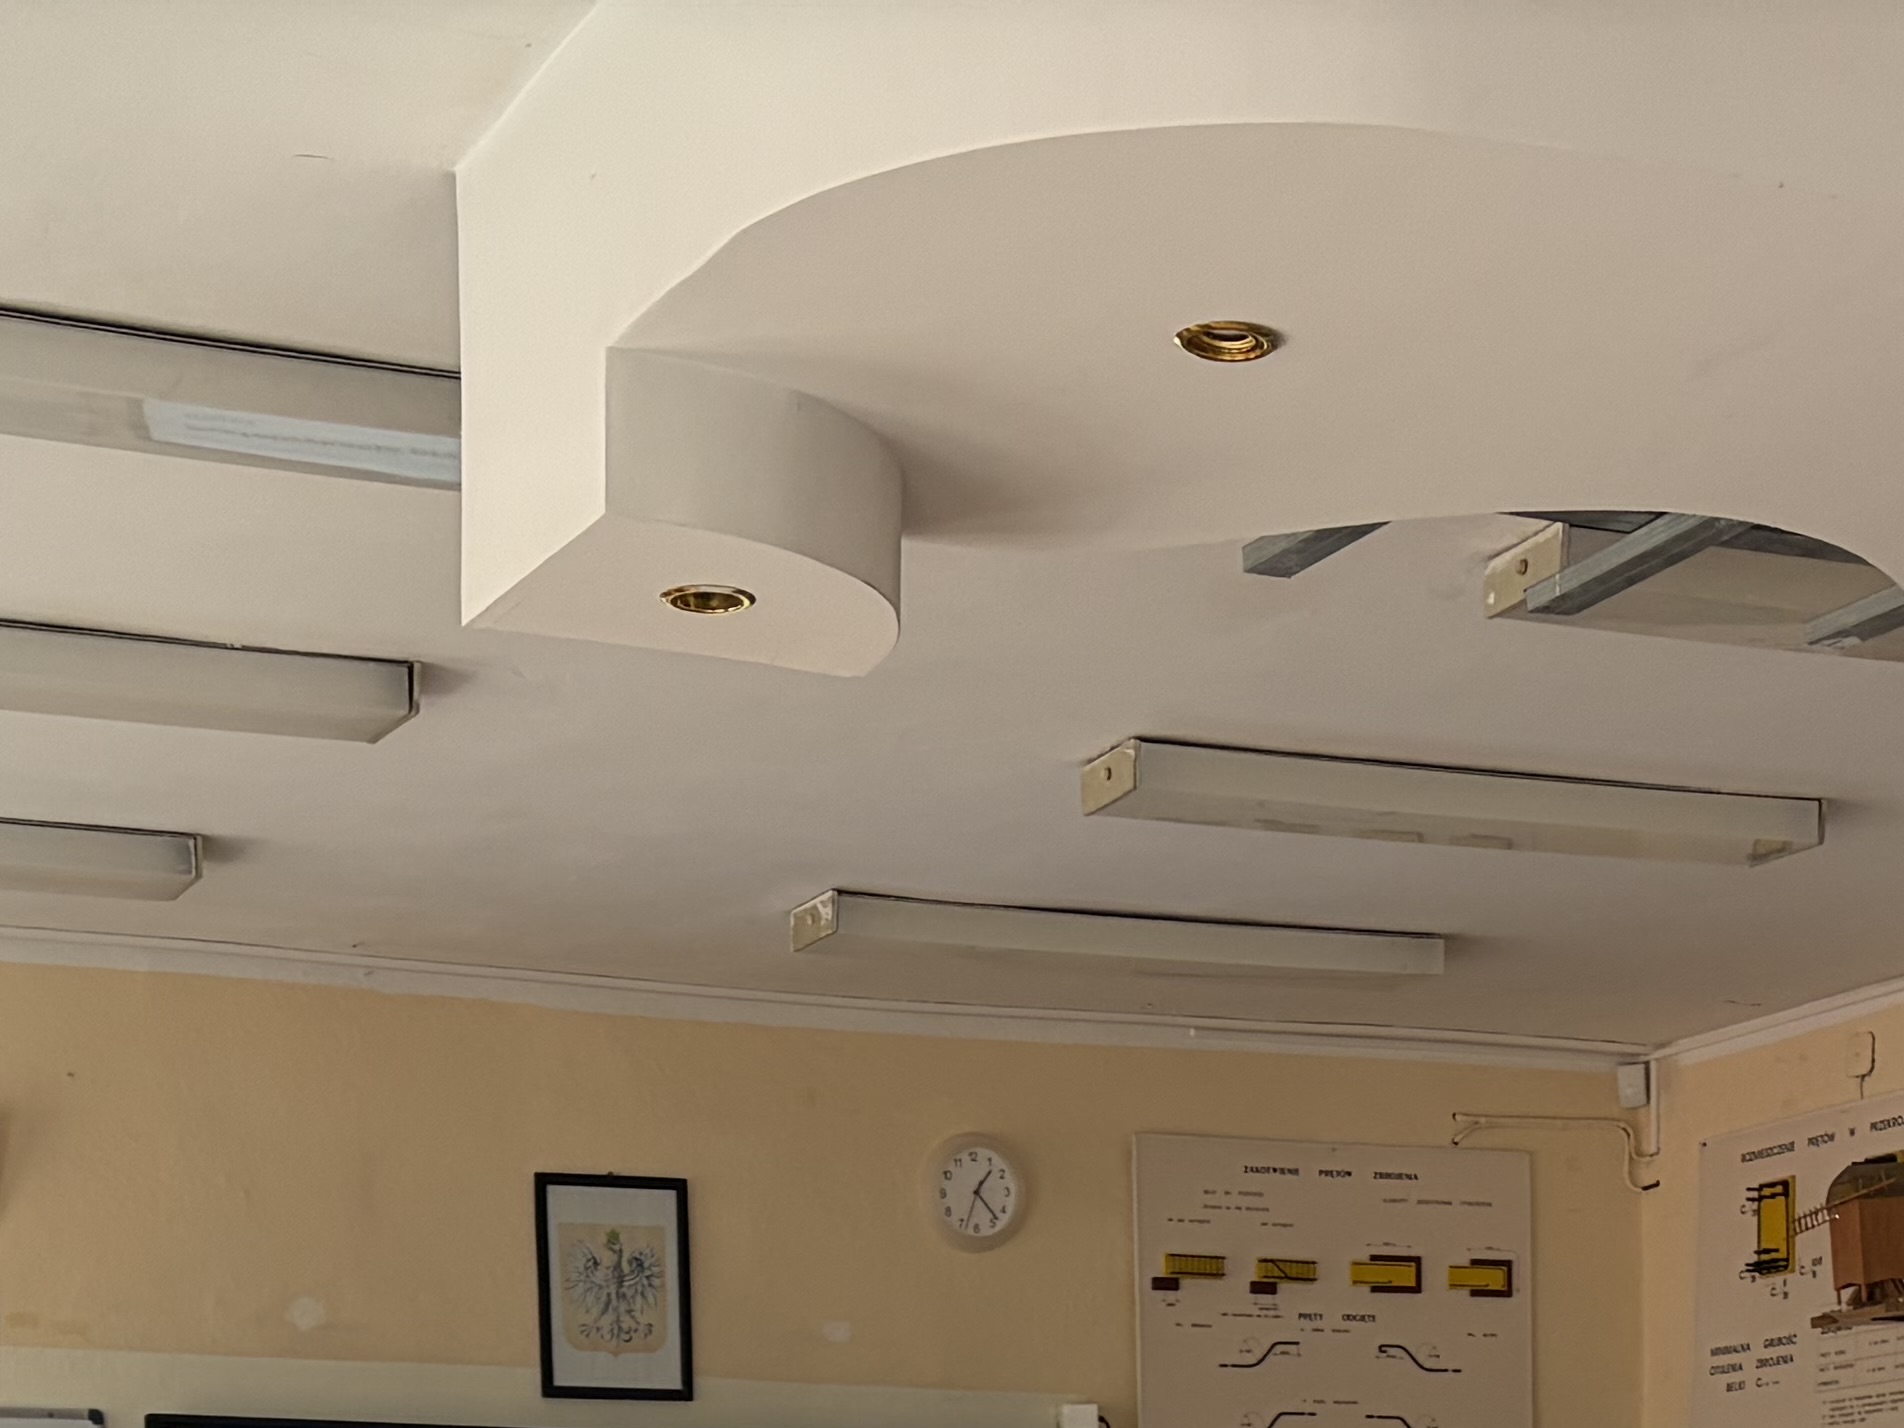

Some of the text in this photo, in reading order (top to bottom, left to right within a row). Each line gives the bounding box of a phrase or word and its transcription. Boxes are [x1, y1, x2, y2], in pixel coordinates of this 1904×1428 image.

[968, 1151, 978, 1162] 12
[953, 1158, 962, 1168] 11
[987, 1157, 992, 1167] 1
[999, 1169, 1006, 1180] 2
